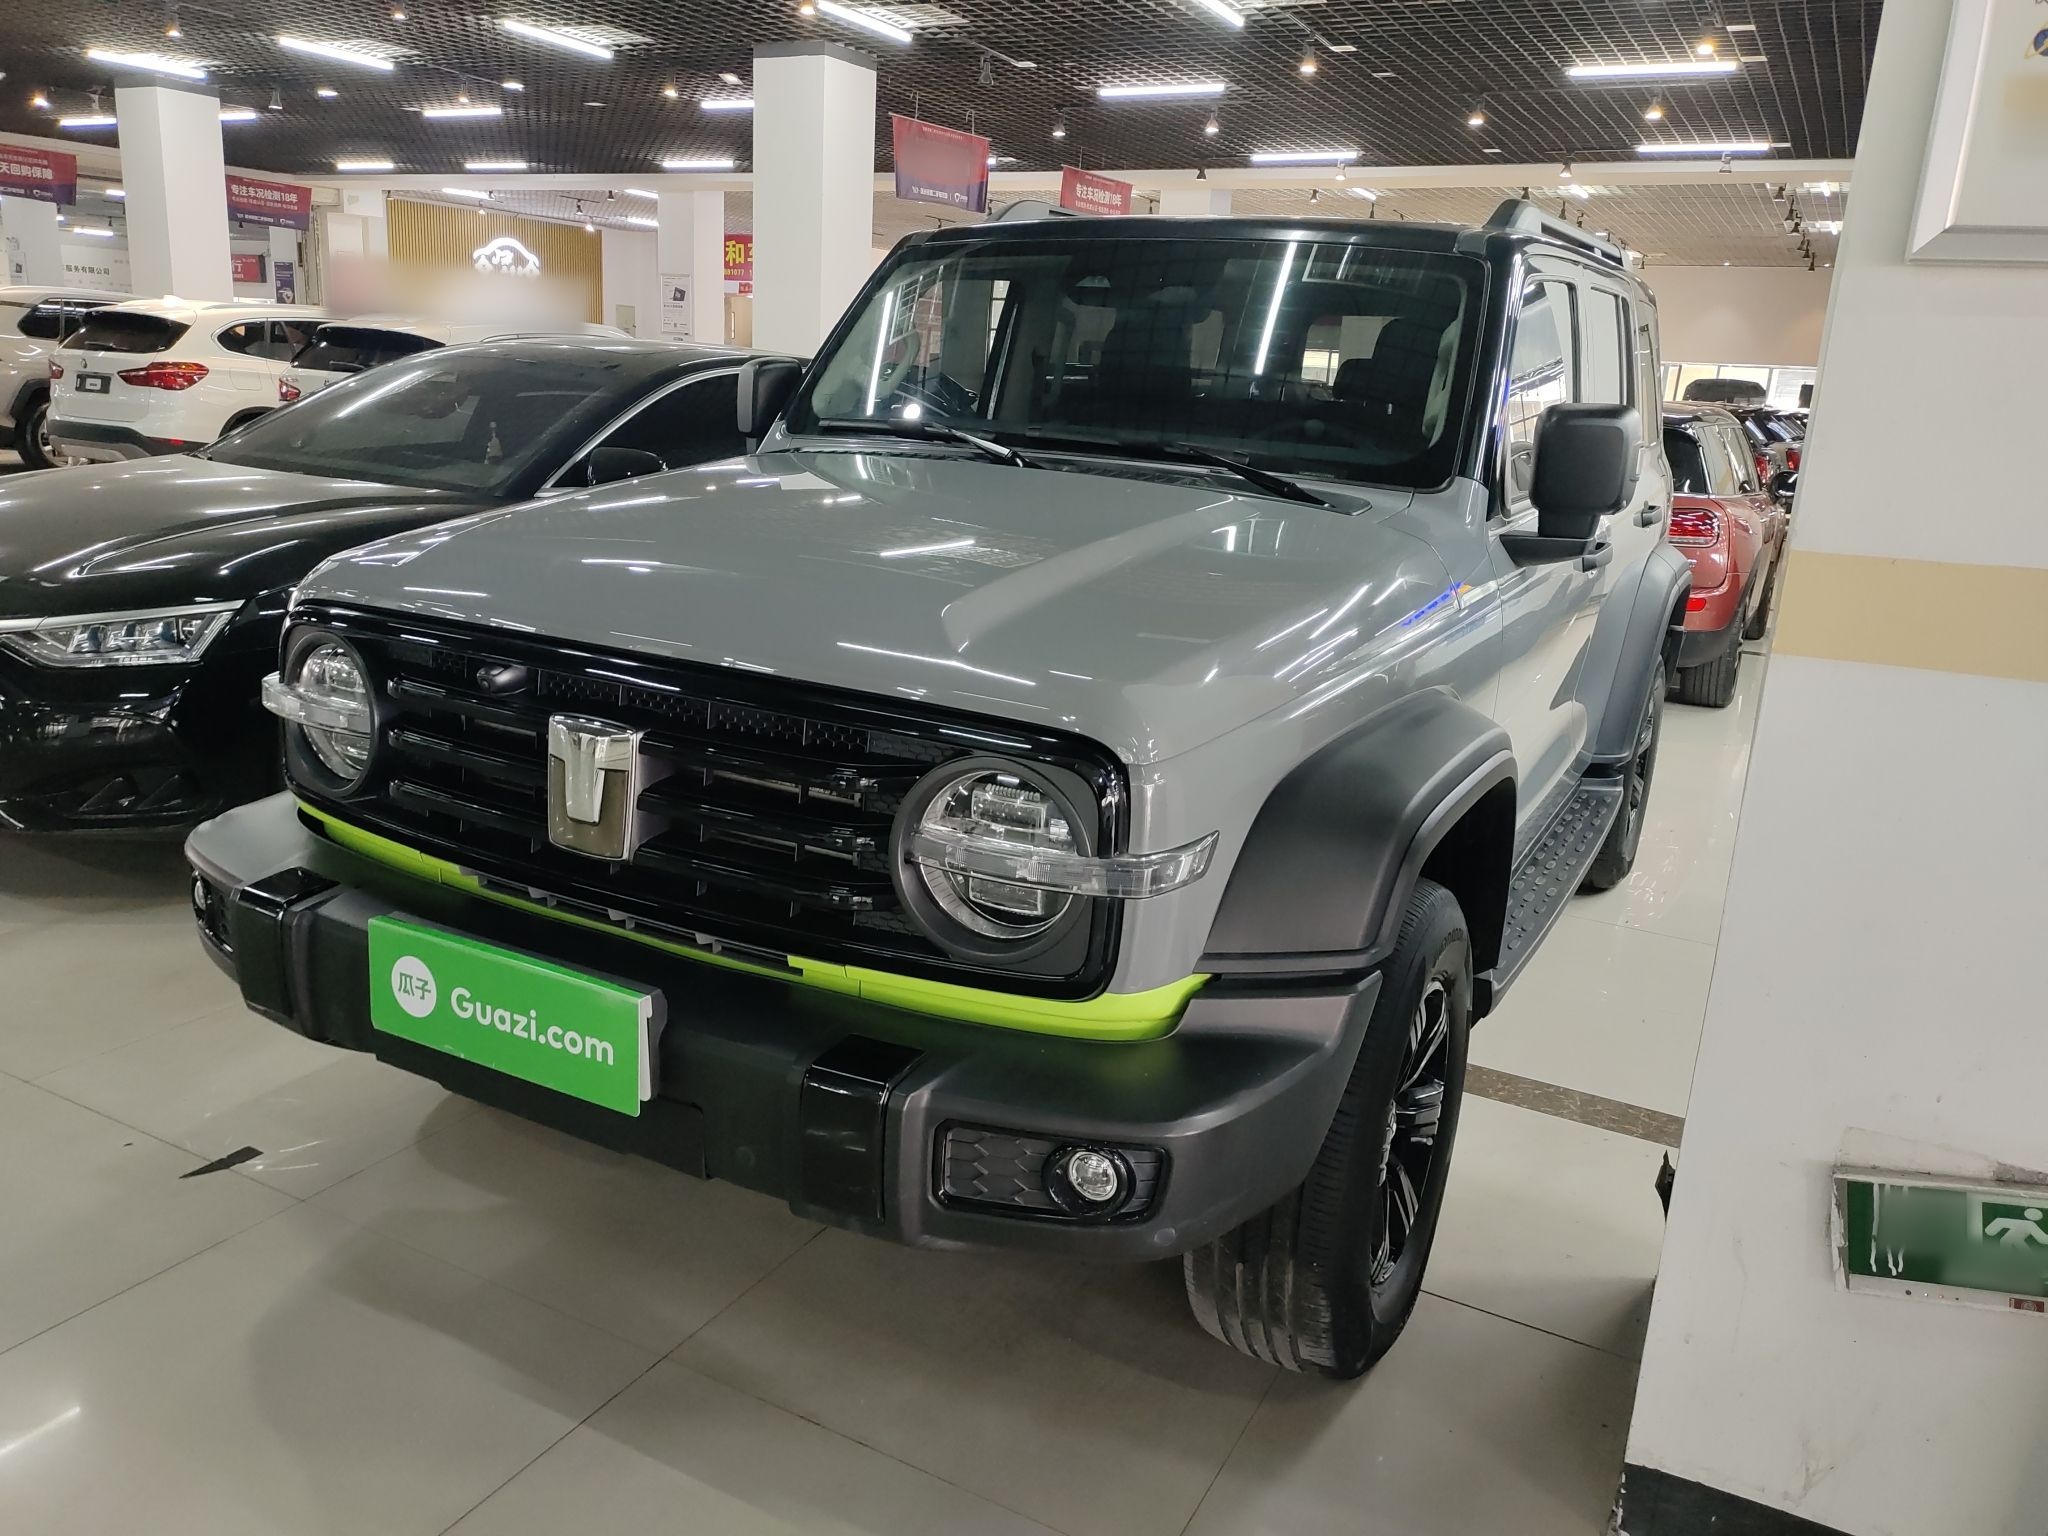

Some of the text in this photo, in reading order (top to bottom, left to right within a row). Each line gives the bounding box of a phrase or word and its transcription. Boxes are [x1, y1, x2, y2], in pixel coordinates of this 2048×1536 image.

[230, 184, 298, 203] 专注车况检测18年
[65, 264, 110, 276] 服务有限公司
[398, 971, 614, 1066] 瓜子 Guazi.com
